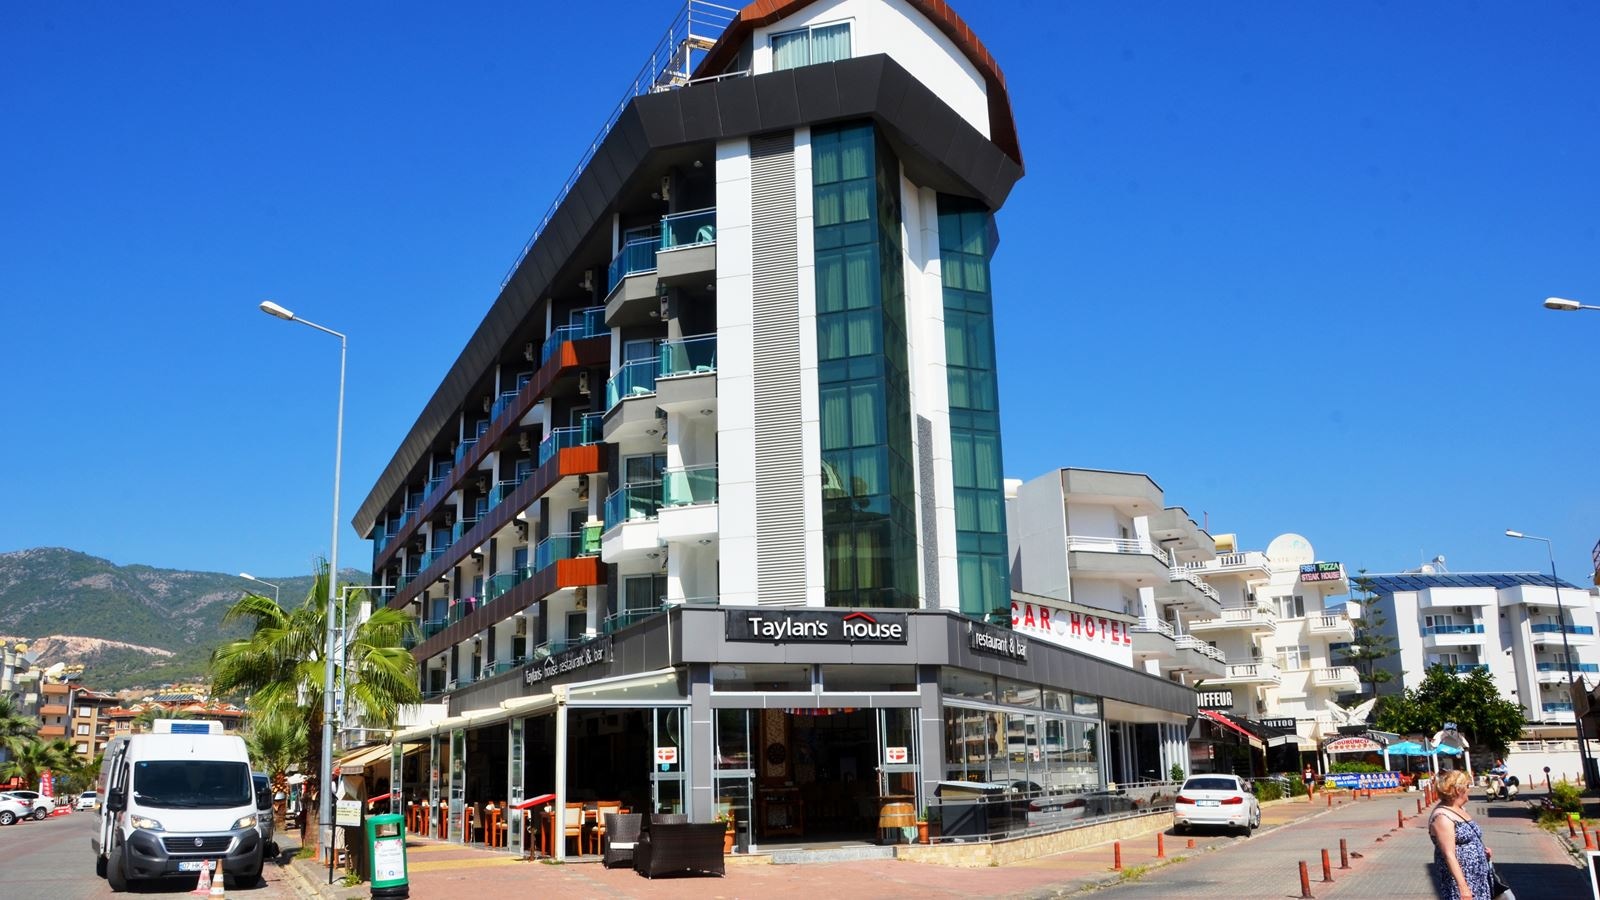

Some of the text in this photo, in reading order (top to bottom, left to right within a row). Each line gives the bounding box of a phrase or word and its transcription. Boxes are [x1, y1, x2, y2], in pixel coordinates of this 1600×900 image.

[1301, 562, 1340, 573] FISH PIZZA
[1301, 571, 1340, 581] STEAK HOUSE
[748, 617, 902, 639] Taylan's house
[1071, 612, 1131, 644] HOTEL
[975, 632, 1026, 656] restaurant & bar
[544, 664, 558, 678] house
[559, 655, 585, 672] restaurant
[585, 648, 592, 664] &
[594, 648, 603, 661] bar
